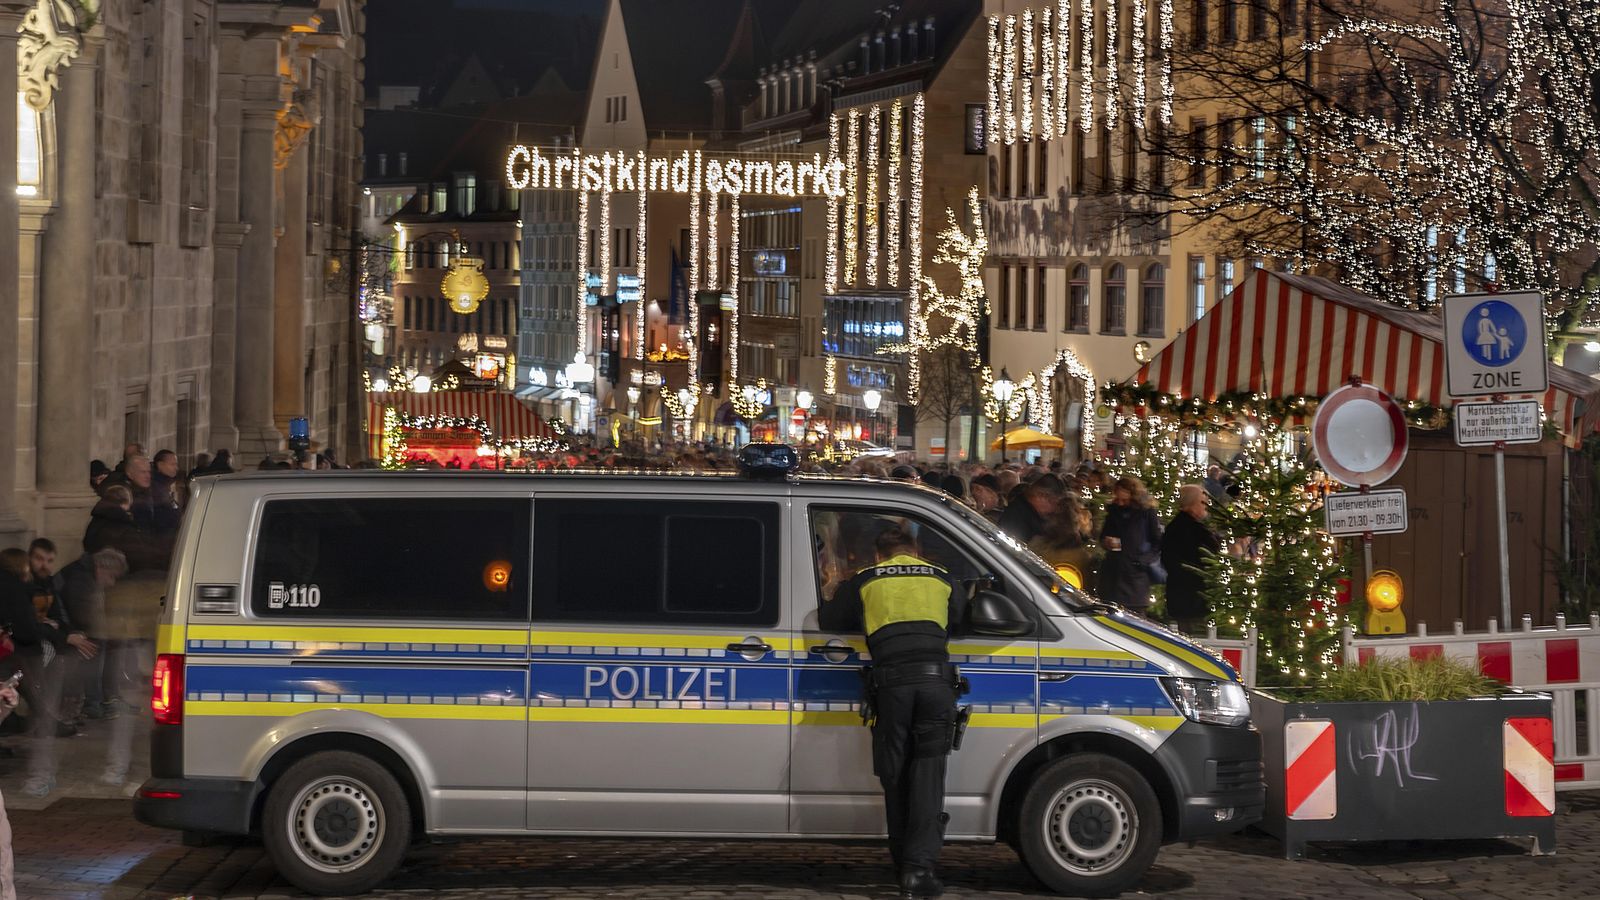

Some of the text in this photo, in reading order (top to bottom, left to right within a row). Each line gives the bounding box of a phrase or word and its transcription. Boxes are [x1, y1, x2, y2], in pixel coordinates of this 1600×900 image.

[506, 144, 846, 197] Christkindlesmarkt
[1472, 371, 1522, 389] ZONE
[1468, 405, 1529, 416] Marktbeschicker
[1466, 415, 1532, 427] nur außerhalb der
[1330, 495, 1402, 511] Lieferverkehr frei
[1332, 519, 1346, 528] von
[876, 566, 935, 576] POLIZEI
[288, 584, 320, 607] 110
[584, 666, 737, 701] POLIZEI
